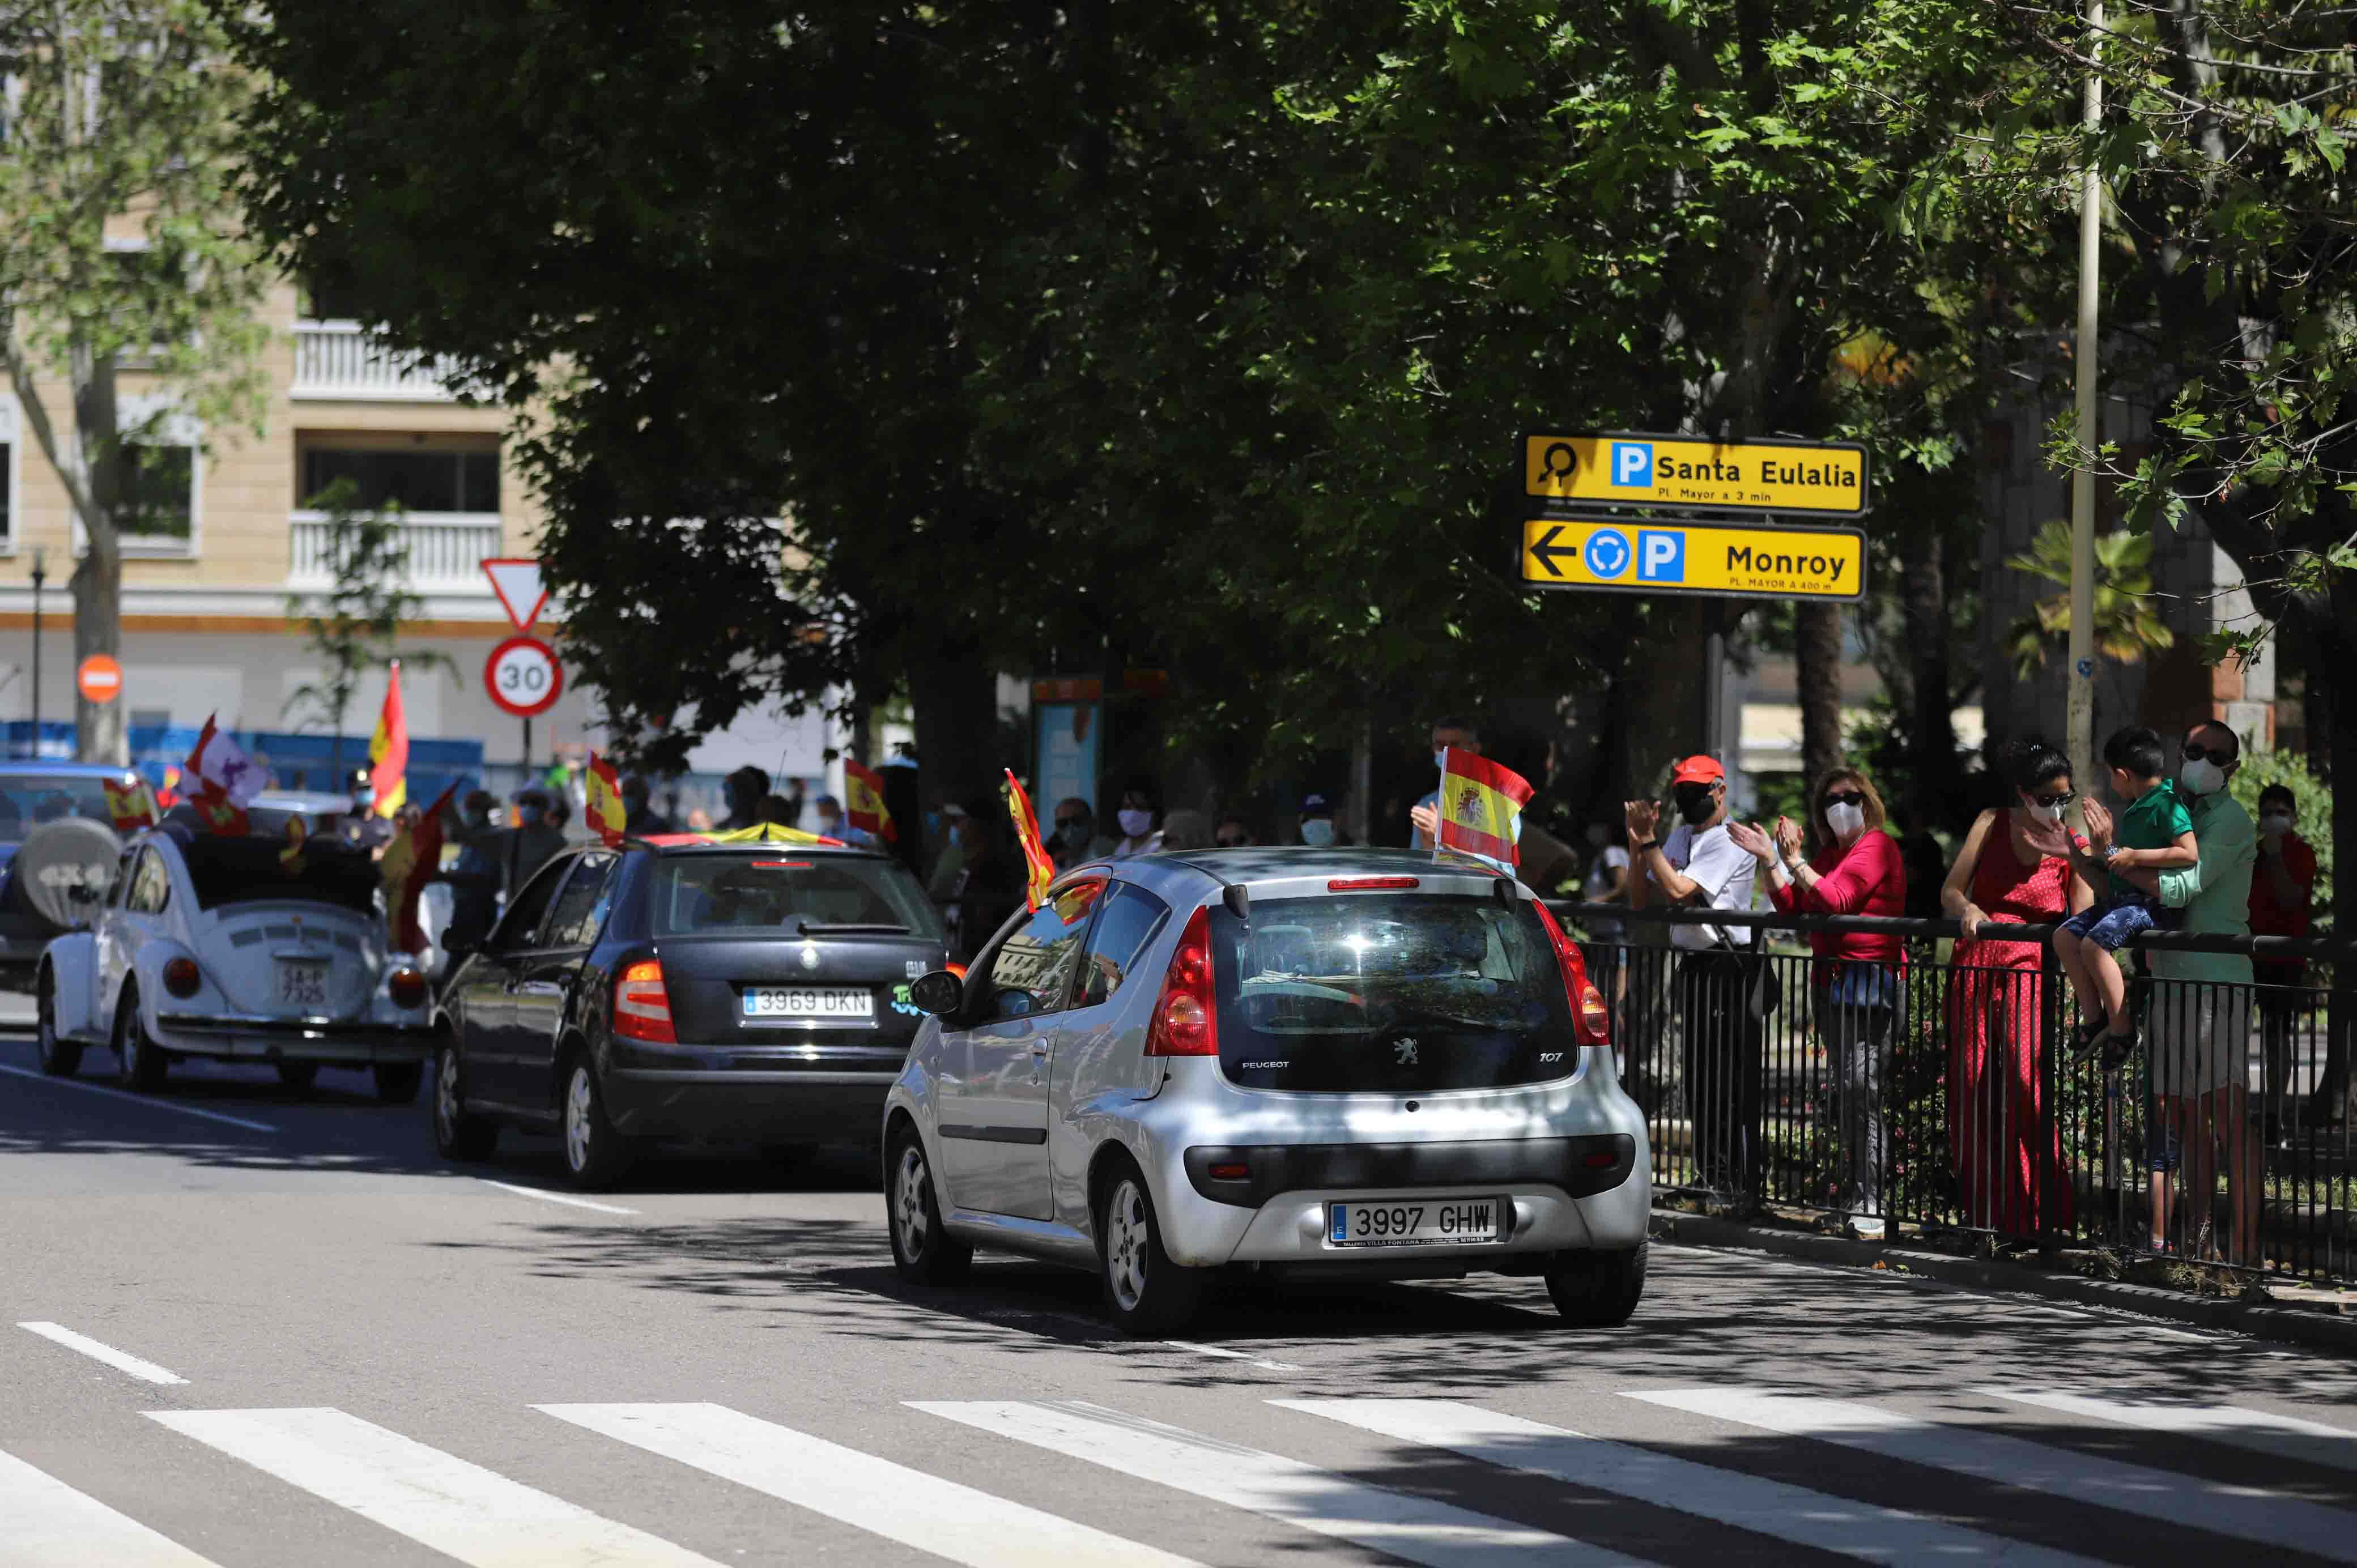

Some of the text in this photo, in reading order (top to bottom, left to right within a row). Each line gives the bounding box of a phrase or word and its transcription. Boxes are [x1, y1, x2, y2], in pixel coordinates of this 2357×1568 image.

[1619, 446, 1647, 483] P
[1657, 457, 1856, 487] Santa Eulalia
[1680, 489, 1715, 501] Mayor
[1737, 492, 1743, 501] 3
[1750, 492, 1771, 502] min
[1645, 535, 1677, 578] P
[1726, 546, 1845, 581] Monroy
[1748, 578, 1785, 589] MAYOR
[1801, 581, 1820, 590] 400
[503, 664, 544, 689] 30
[760, 990, 816, 1011] 3969
[824, 990, 866, 1011] DKN
[1540, 1052, 1564, 1062] 107
[1355, 1204, 1489, 1236] 3997 GHW
